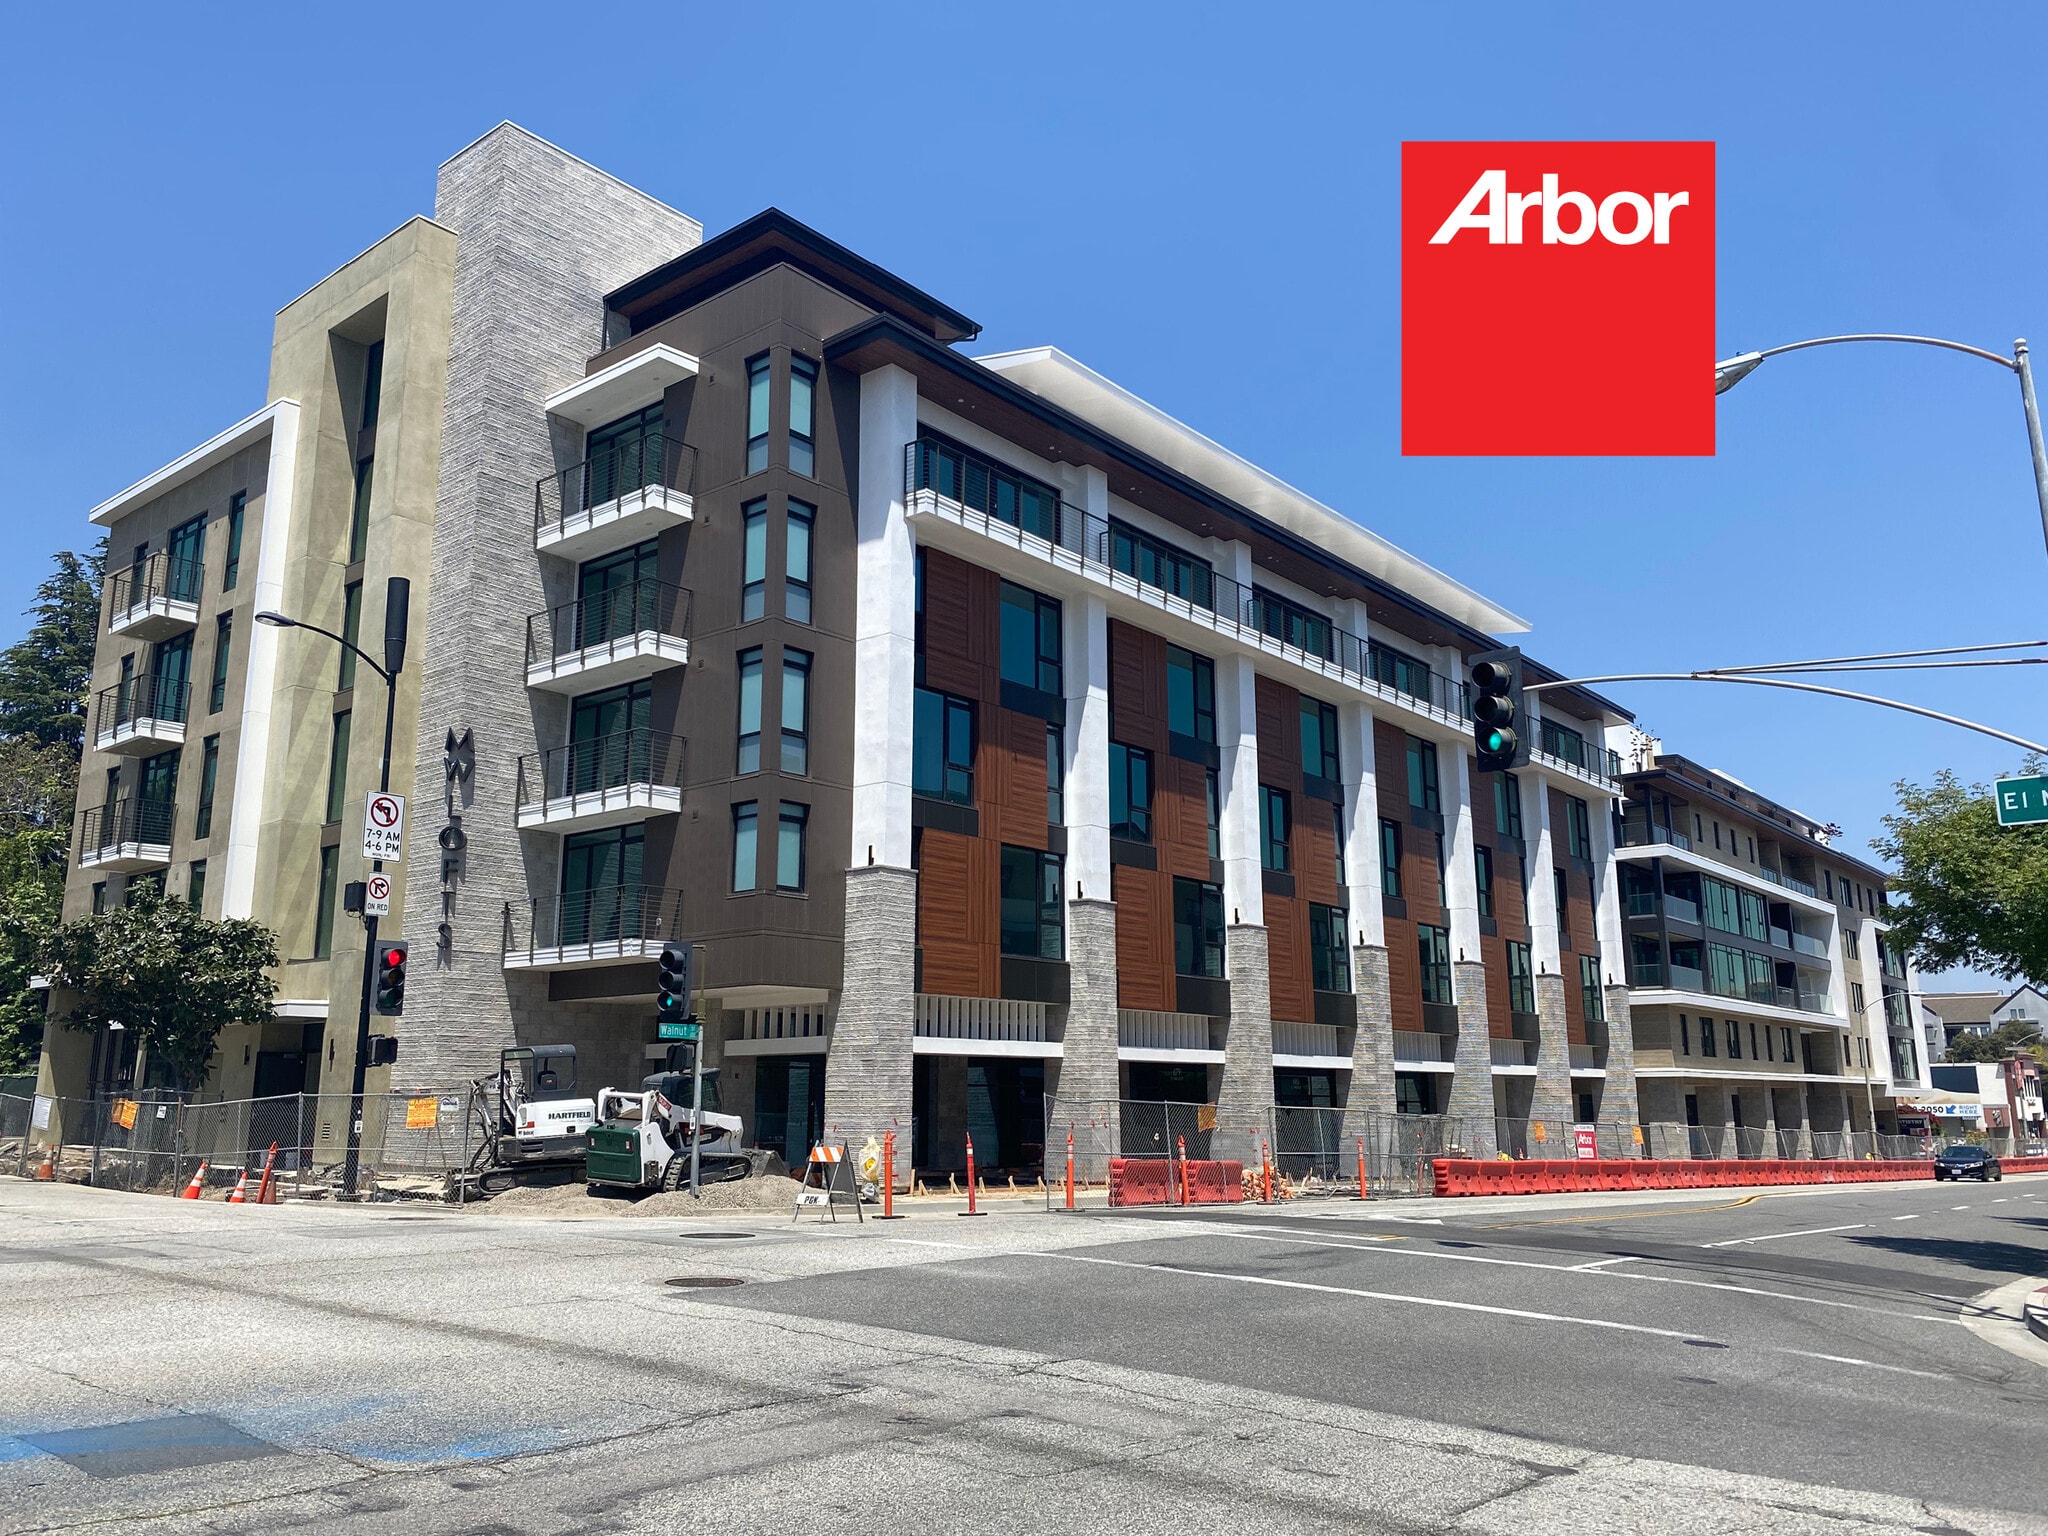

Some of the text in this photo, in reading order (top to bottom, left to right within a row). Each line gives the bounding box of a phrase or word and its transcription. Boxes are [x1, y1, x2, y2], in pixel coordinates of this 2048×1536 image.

[2003, 791, 2028, 811] El
[366, 828, 400, 842] 7-9 AM
[365, 840, 400, 853] 4-6 PM
[367, 902, 388, 911] ON RED
[660, 1025, 688, 1036] Walnut
[548, 1111, 592, 1120] HARTFIELD
